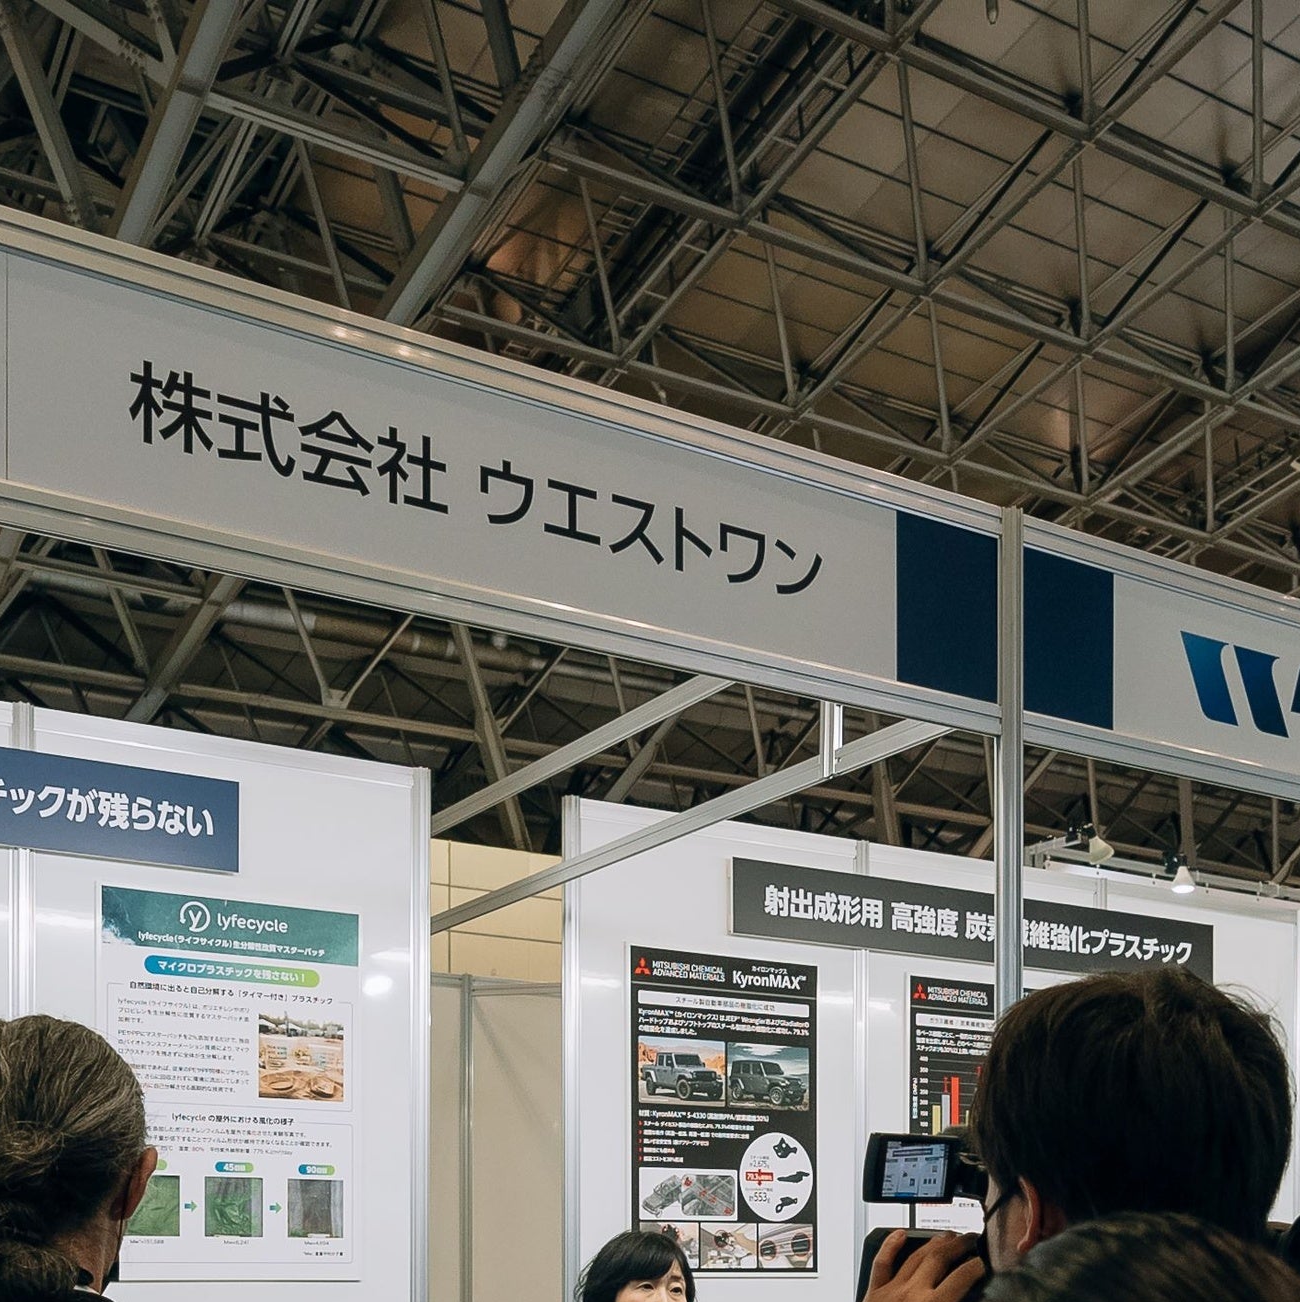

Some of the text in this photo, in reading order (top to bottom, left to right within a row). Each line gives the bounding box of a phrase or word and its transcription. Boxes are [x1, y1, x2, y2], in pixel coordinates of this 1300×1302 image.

[129, 359, 823, 595] 株式会社 ウエストワン
[217, 912, 288, 934] lyfecycle
[764, 884, 1193, 966] 射出成形用 高強度 炭維強化プラスチック
[652, 960, 724, 974] MITSUBISHI CHEMICAL
[652, 968, 726, 982] ADVANCED MATERIALS
